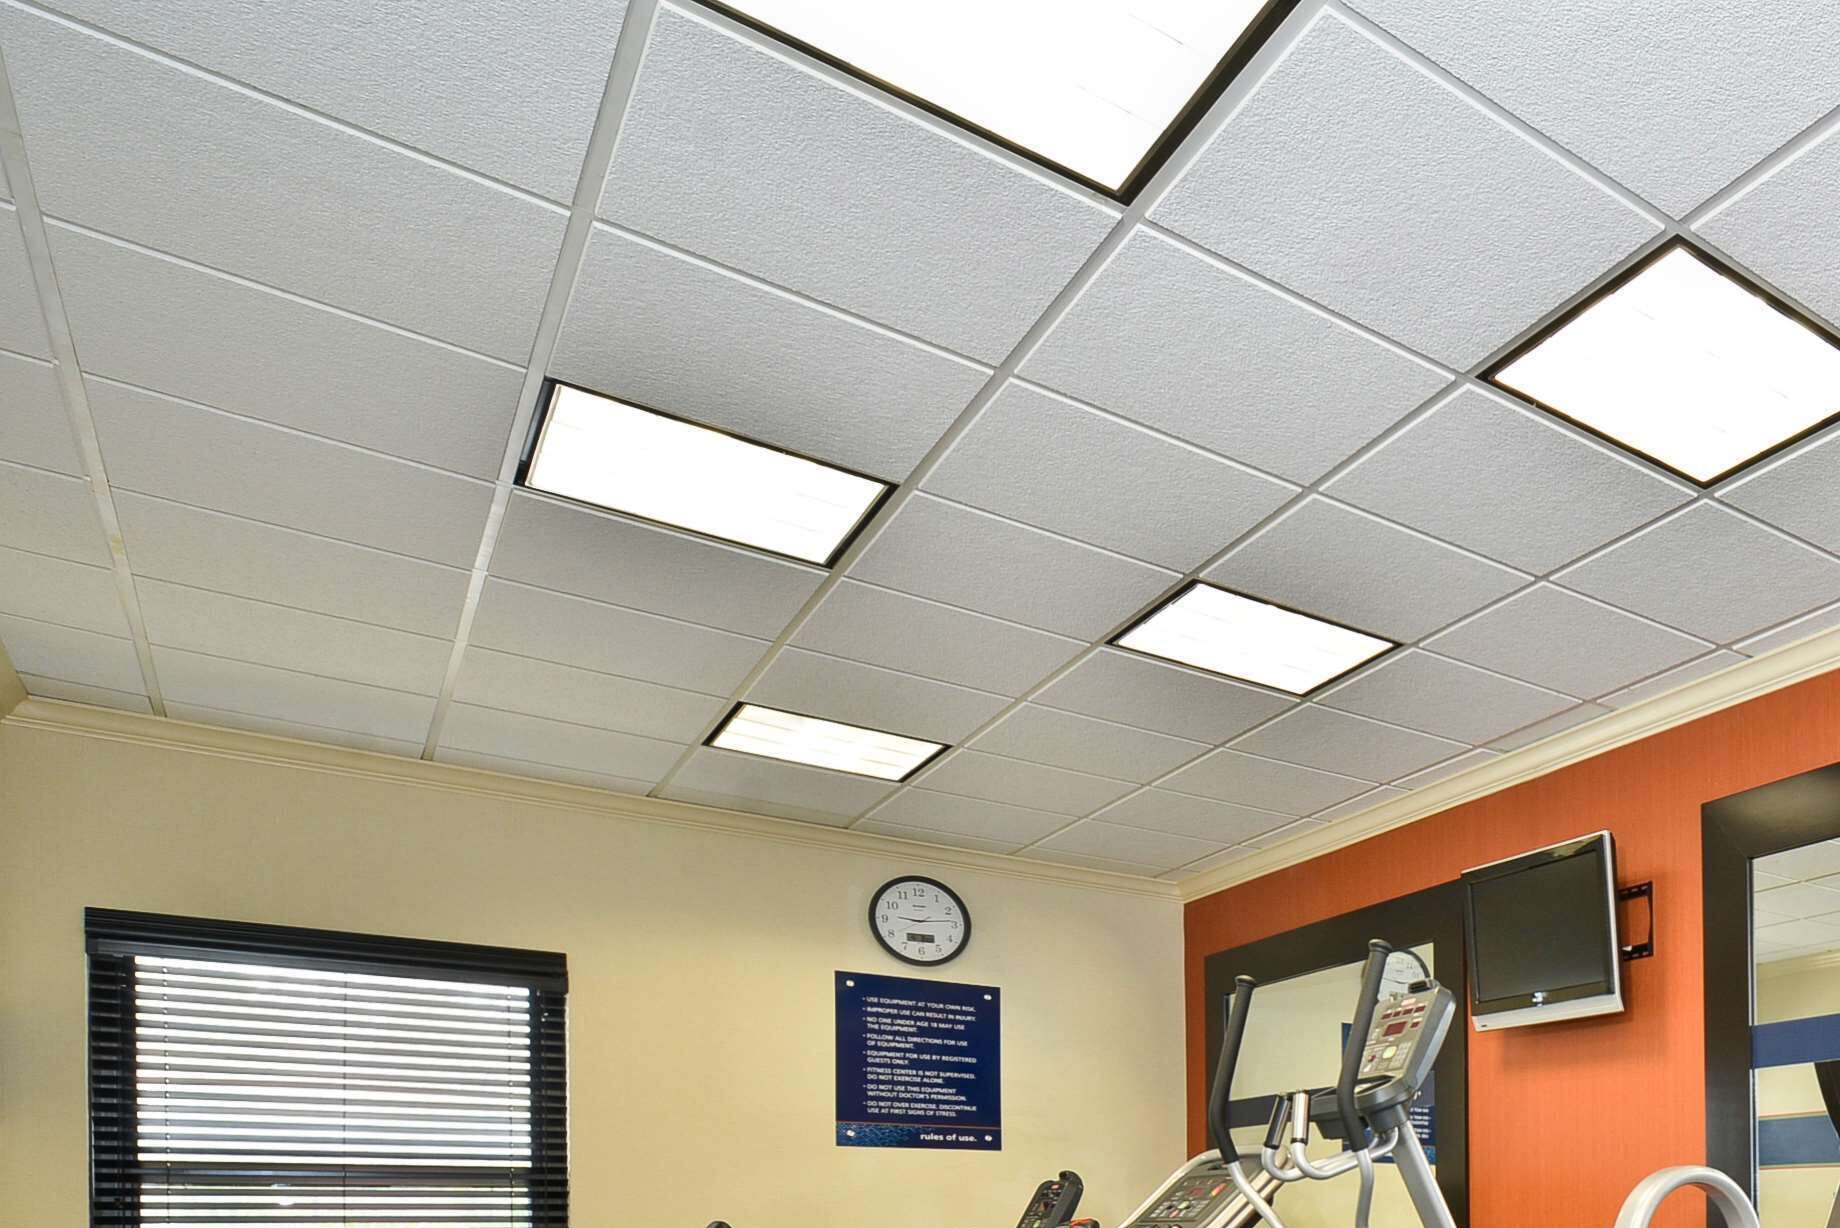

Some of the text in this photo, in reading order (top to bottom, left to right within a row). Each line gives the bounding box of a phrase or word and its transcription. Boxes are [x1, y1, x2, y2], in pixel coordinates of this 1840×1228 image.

[898, 891, 908, 900] 11
[913, 888, 925, 897] 12
[934, 894, 939, 903] 1
[886, 901, 898, 910] 10
[945, 907, 951, 915] 2
[882, 915, 888, 923] 9
[952, 921, 958, 929] 3
[902, 942, 908, 950] 7
[918, 947, 925, 955] 6
[880, 998, 916, 1006] EQUIPMENT
